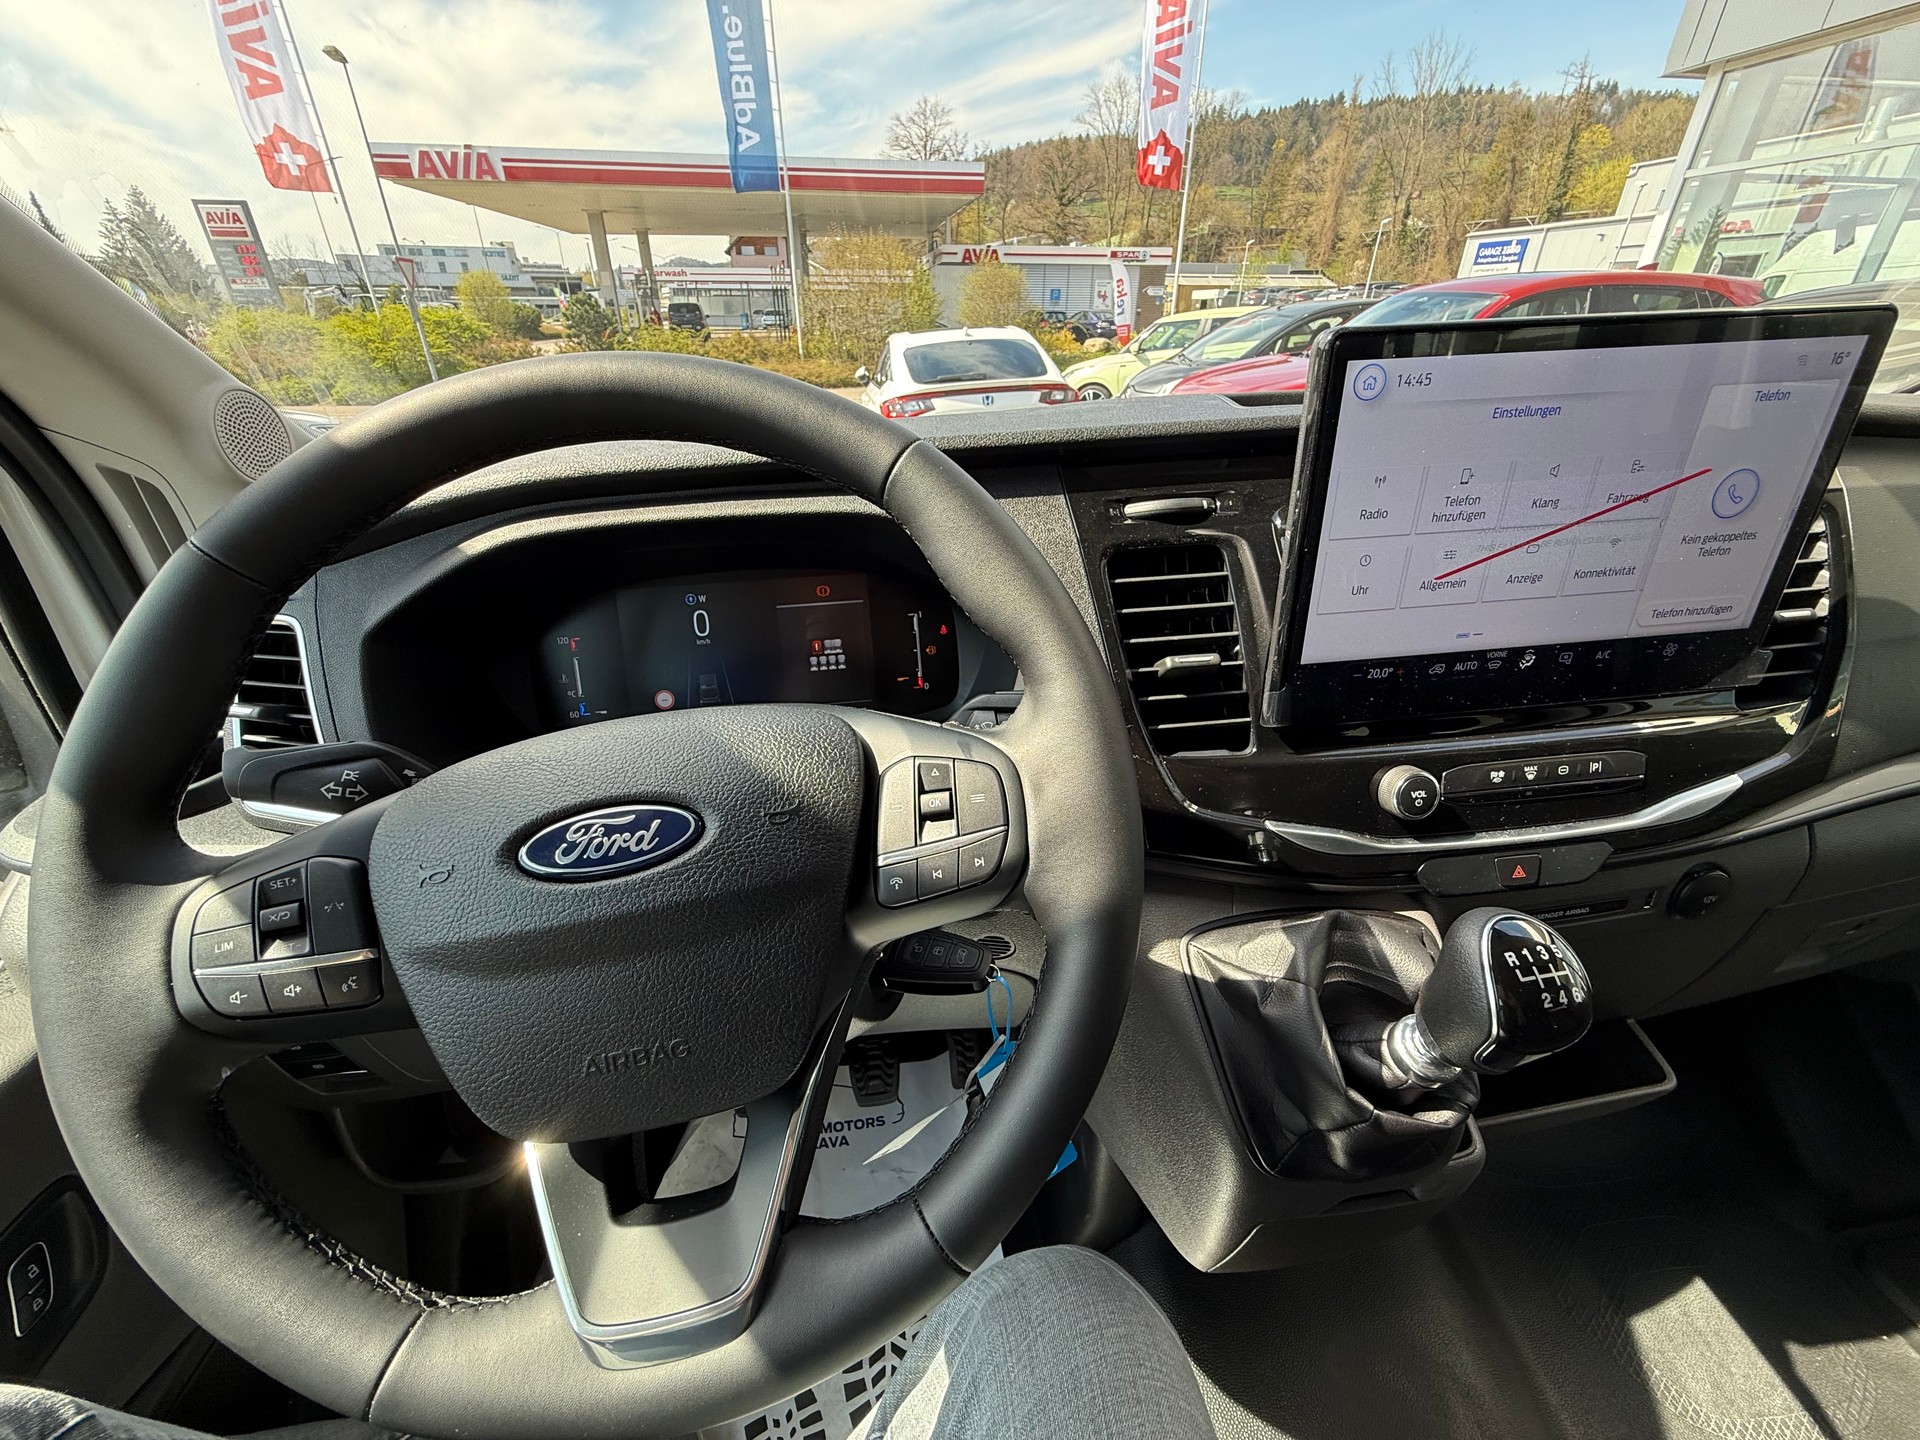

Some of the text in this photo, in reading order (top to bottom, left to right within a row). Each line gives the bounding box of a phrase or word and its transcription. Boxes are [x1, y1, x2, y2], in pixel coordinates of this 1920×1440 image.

[418, 144, 499, 180] AVIA
[205, 208, 244, 225] AVIA
[654, 268, 688, 277] arwash
[1830, 351, 1852, 366] 16°
[1397, 372, 1433, 388] 14:45
[1755, 389, 1791, 402] Telefon
[1492, 405, 1562, 419] Einstellungen
[1444, 495, 1481, 507] Telefon
[1531, 498, 1560, 510] Klang
[1359, 508, 1389, 520] Radio
[1431, 510, 1486, 523] hinzufügen
[1680, 530, 1758, 546] Kein gekoppeltes
[1698, 546, 1731, 557] Telefon
[1505, 572, 1544, 585] Anzeige
[1573, 565, 1637, 580] Konnektivität
[1351, 586, 1370, 596] Uhr
[1418, 577, 1467, 592] Allgemein
[698, 594, 707, 603] W
[1651, 604, 1733, 619] Telefon hinzufügen
[693, 609, 710, 637] 0
[556, 637, 569, 645] 120
[1486, 650, 1508, 659] VORNE
[1595, 650, 1612, 660] A/C
[1454, 661, 1478, 671] AUTO
[1367, 667, 1394, 680] 20,0°
[569, 711, 579, 719] 60
[1524, 764, 1538, 772] MAX
[1411, 790, 1428, 799] VOL
[929, 798, 941, 808] OK
[555, 814, 662, 865] Ford
[1564, 907, 1590, 916] AIRBAG
[214, 940, 234, 954] LIM
[1504, 943, 1563, 967] R 1 3 5
[1541, 986, 1583, 1009] 2 4 6
[583, 1037, 692, 1077] AIRBAG
[820, 1115, 886, 1134] MOTORS
[816, 1135, 850, 1150] AVA
